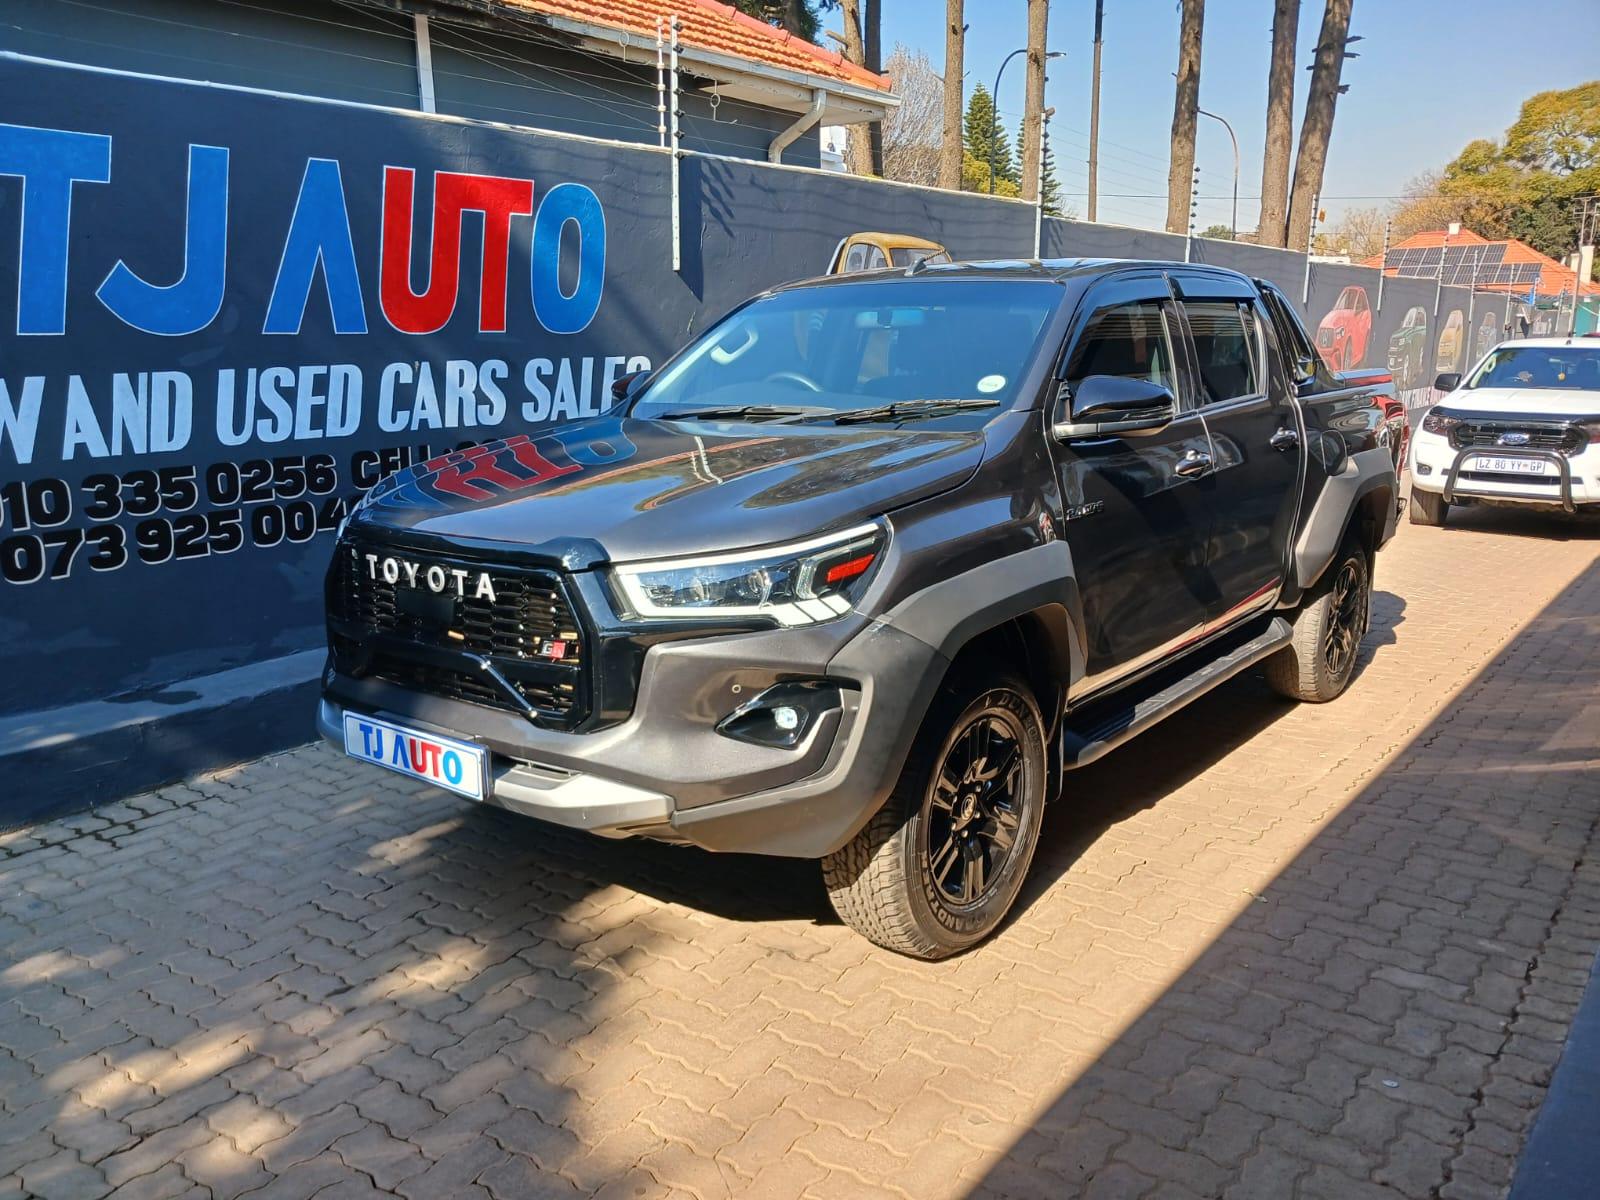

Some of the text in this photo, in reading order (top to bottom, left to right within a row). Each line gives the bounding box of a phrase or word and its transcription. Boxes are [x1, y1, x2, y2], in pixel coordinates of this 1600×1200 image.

[0, 122, 606, 336] TJ AUTO
[62, 371, 193, 461] AND
[216, 364, 363, 446] USED
[378, 359, 509, 432] CARS
[0, 478, 72, 532] 10
[81, 465, 198, 522] 335
[205, 454, 338, 507] 0256
[1, 523, 129, 585] 073
[135, 508, 244, 565] 925
[365, 553, 497, 602] TOYOTA
[359, 722, 463, 785] TJ AUTO
